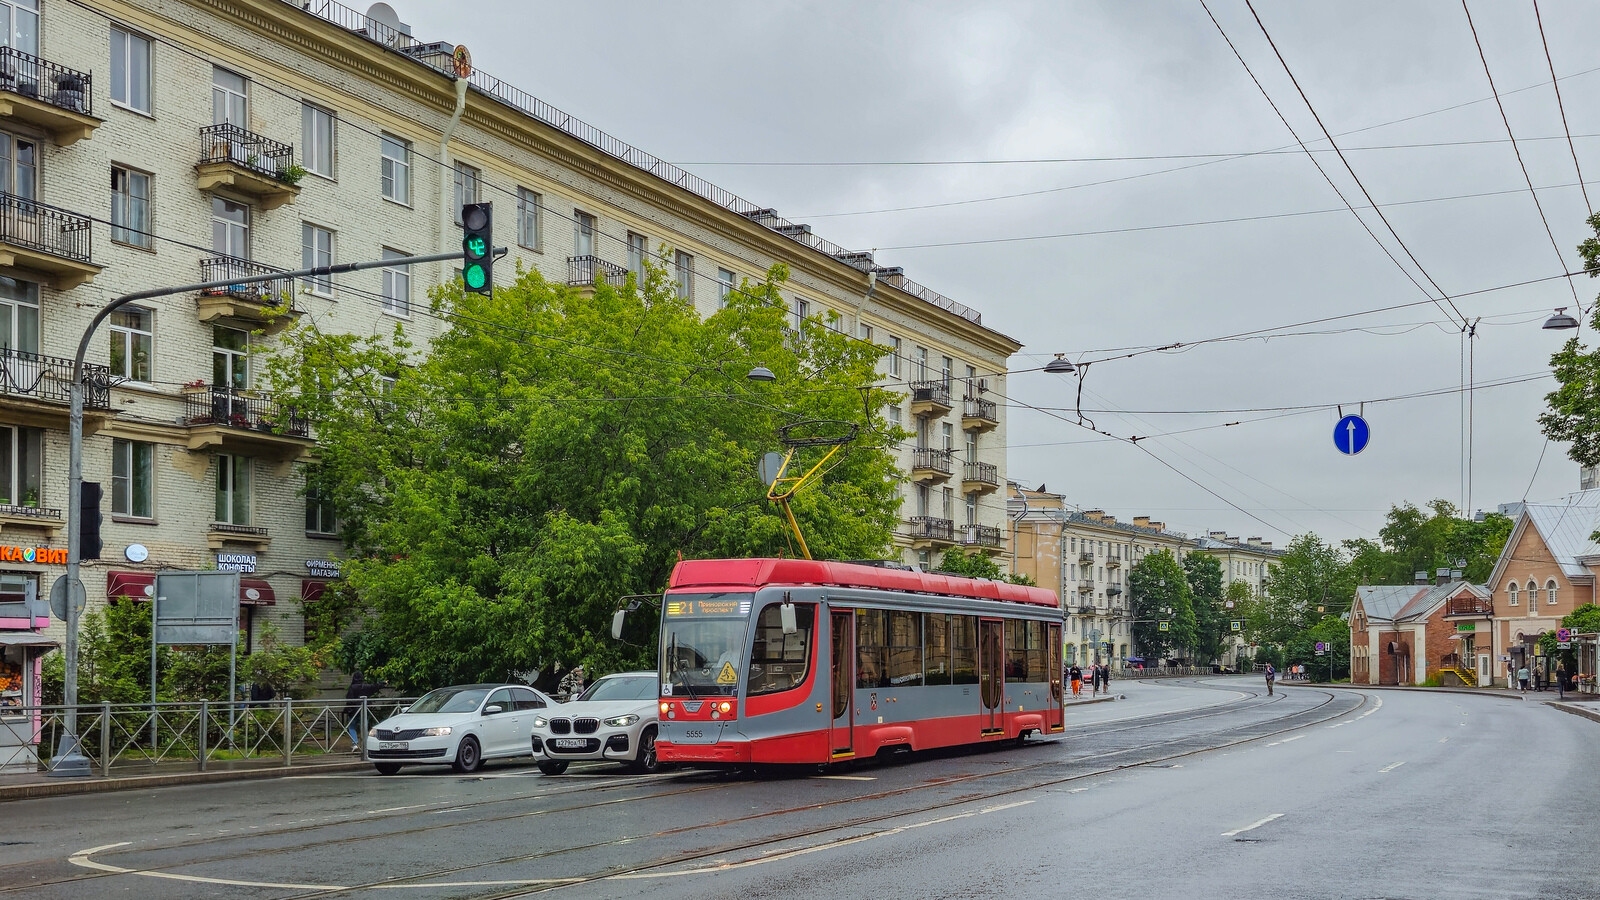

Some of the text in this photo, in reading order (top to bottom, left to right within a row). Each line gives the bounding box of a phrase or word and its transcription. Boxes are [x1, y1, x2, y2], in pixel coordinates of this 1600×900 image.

[468, 239, 485, 256] 42
[36, 548, 68, 564] ВИТ
[218, 553, 257, 566] ШОКОЛАД
[218, 563, 256, 573] КОНФЕТЫ
[306, 560, 342, 569] ФИРМЕНН
[311, 568, 340, 578] МАГАЗИН
[680, 601, 694, 614] 21
[698, 600, 737, 608] Приморский
[686, 730, 703, 738] 5555
